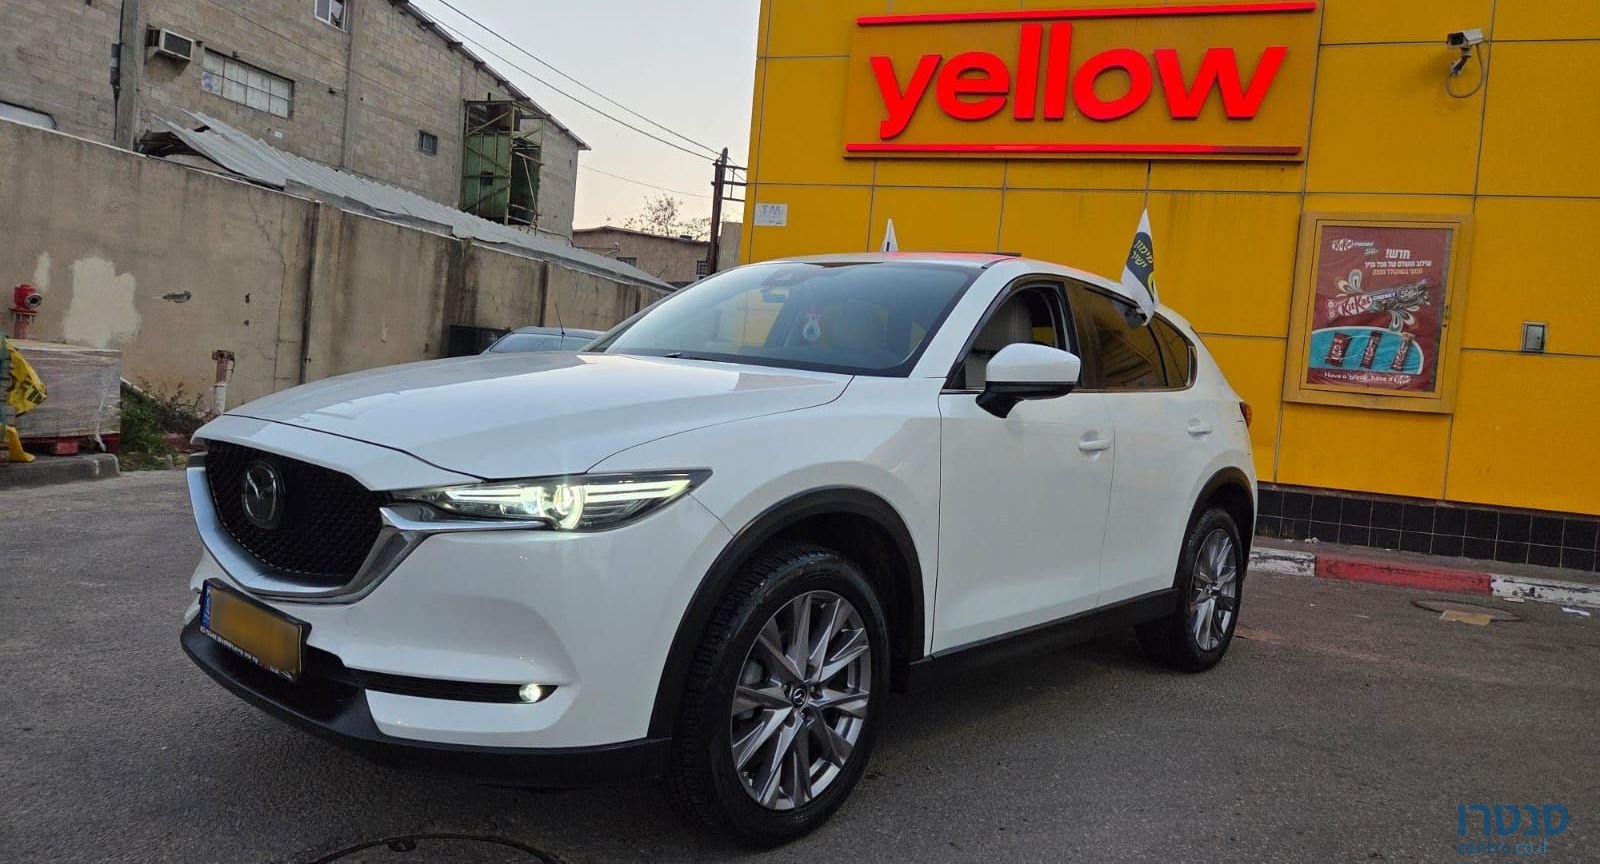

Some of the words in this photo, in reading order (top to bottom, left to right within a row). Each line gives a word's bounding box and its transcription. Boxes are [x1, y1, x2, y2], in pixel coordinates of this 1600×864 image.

[870, 22, 1288, 140] yellow
[1385, 248, 1411, 260] חדש!
[1338, 294, 1372, 316] KitKat
